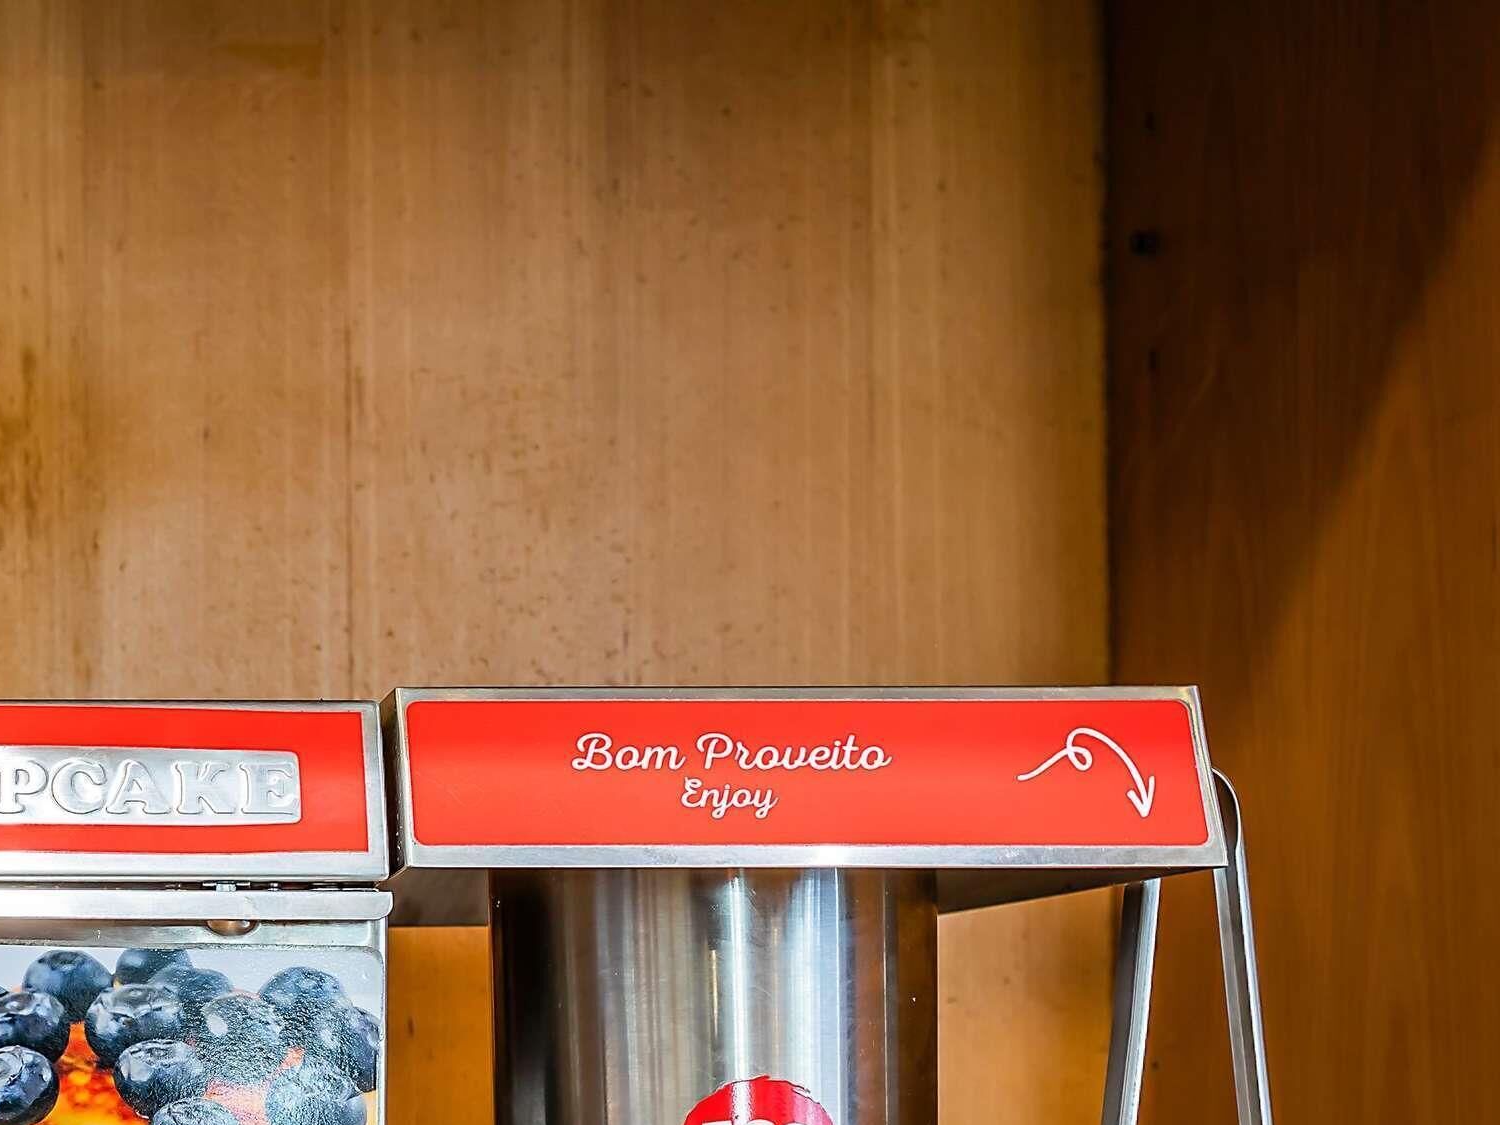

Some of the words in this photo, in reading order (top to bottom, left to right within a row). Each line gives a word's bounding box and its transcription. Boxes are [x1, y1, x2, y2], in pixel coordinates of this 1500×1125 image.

[571, 733, 686, 770] Bom
[696, 733, 892, 770] Proveito
[681, 776, 778, 819] Enjoy
